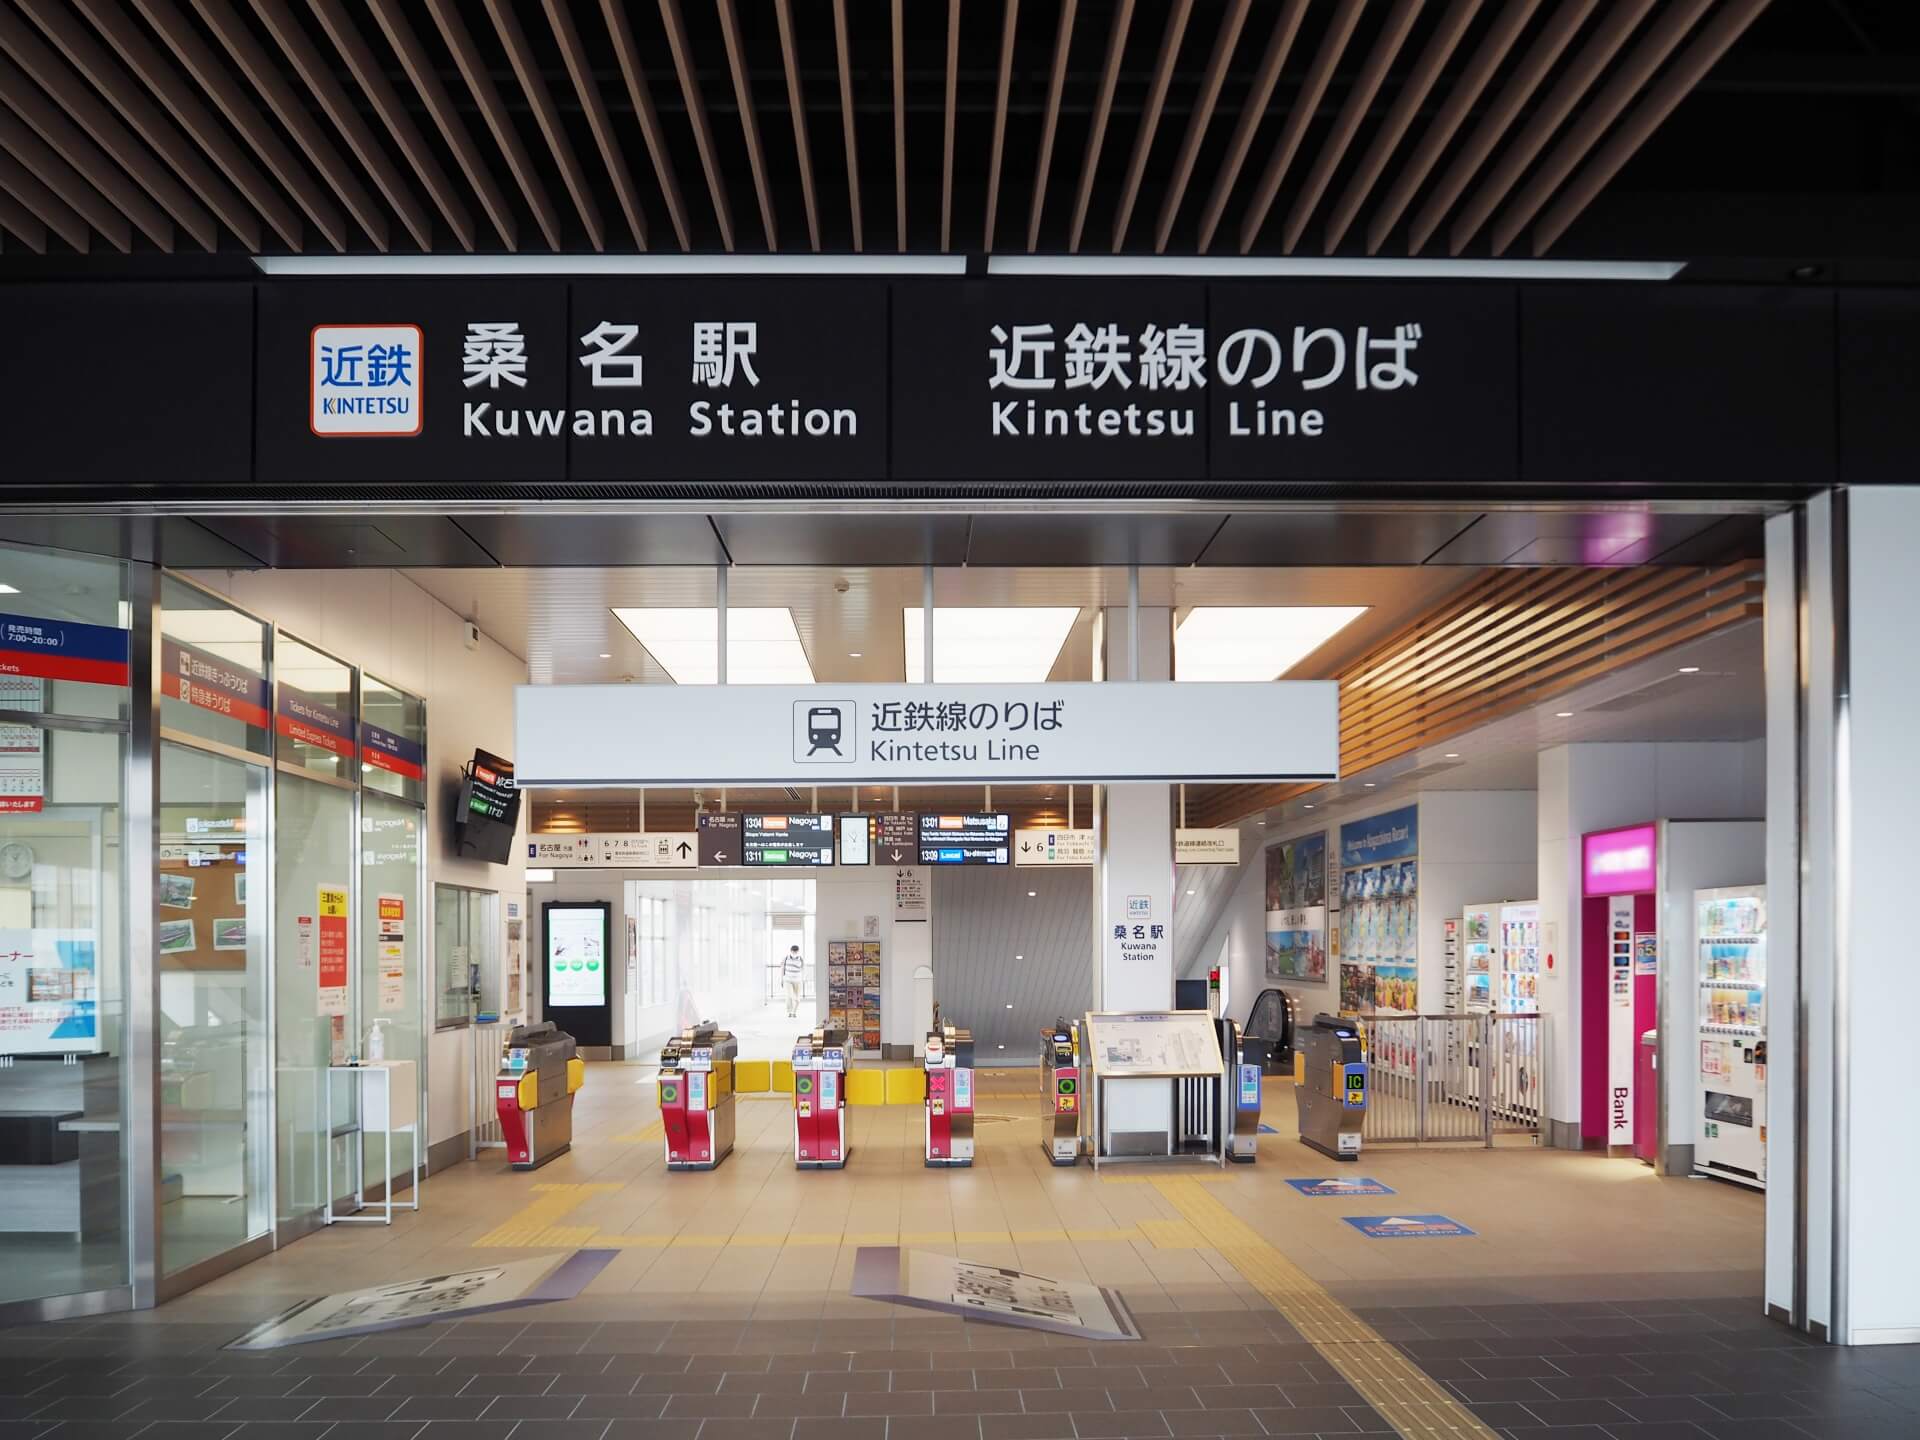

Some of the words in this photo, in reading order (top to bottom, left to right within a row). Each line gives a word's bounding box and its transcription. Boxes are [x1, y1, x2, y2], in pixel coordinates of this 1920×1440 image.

[989, 323, 1422, 390] 近鉄線のりば
[321, 343, 412, 388] 近鉄
[323, 396, 409, 415] KINTETSU
[463, 401, 654, 436] Kuwana
[690, 399, 857, 436] Station
[992, 400, 1195, 436] Kintetsu
[1230, 400, 1325, 436] Line
[191, 660, 248, 694] 近鉄線きっぷうりば
[191, 686, 231, 713] 特急券うりば
[872, 700, 1065, 731] 近鉄線のりば
[871, 739, 977, 760] Kintetsu
[988, 739, 1040, 760] Line
[745, 818, 762, 828] 13:04
[788, 817, 818, 827] Nagoya
[921, 817, 938, 828] 13:01
[540, 844, 561, 852] 名古屋
[1036, 842, 1044, 852] 6
[745, 851, 761, 861] 13:11
[788, 850, 818, 860] Nagoya
[921, 850, 938, 861] 13:09
[1129, 899, 1149, 910] 近鉄
[1121, 942, 1157, 950] Kuwana
[1123, 953, 1154, 961] Station
[826, 1050, 840, 1058] IC
[1349, 1076, 1362, 1089] IC
[1614, 1087, 1629, 1130] Bank
